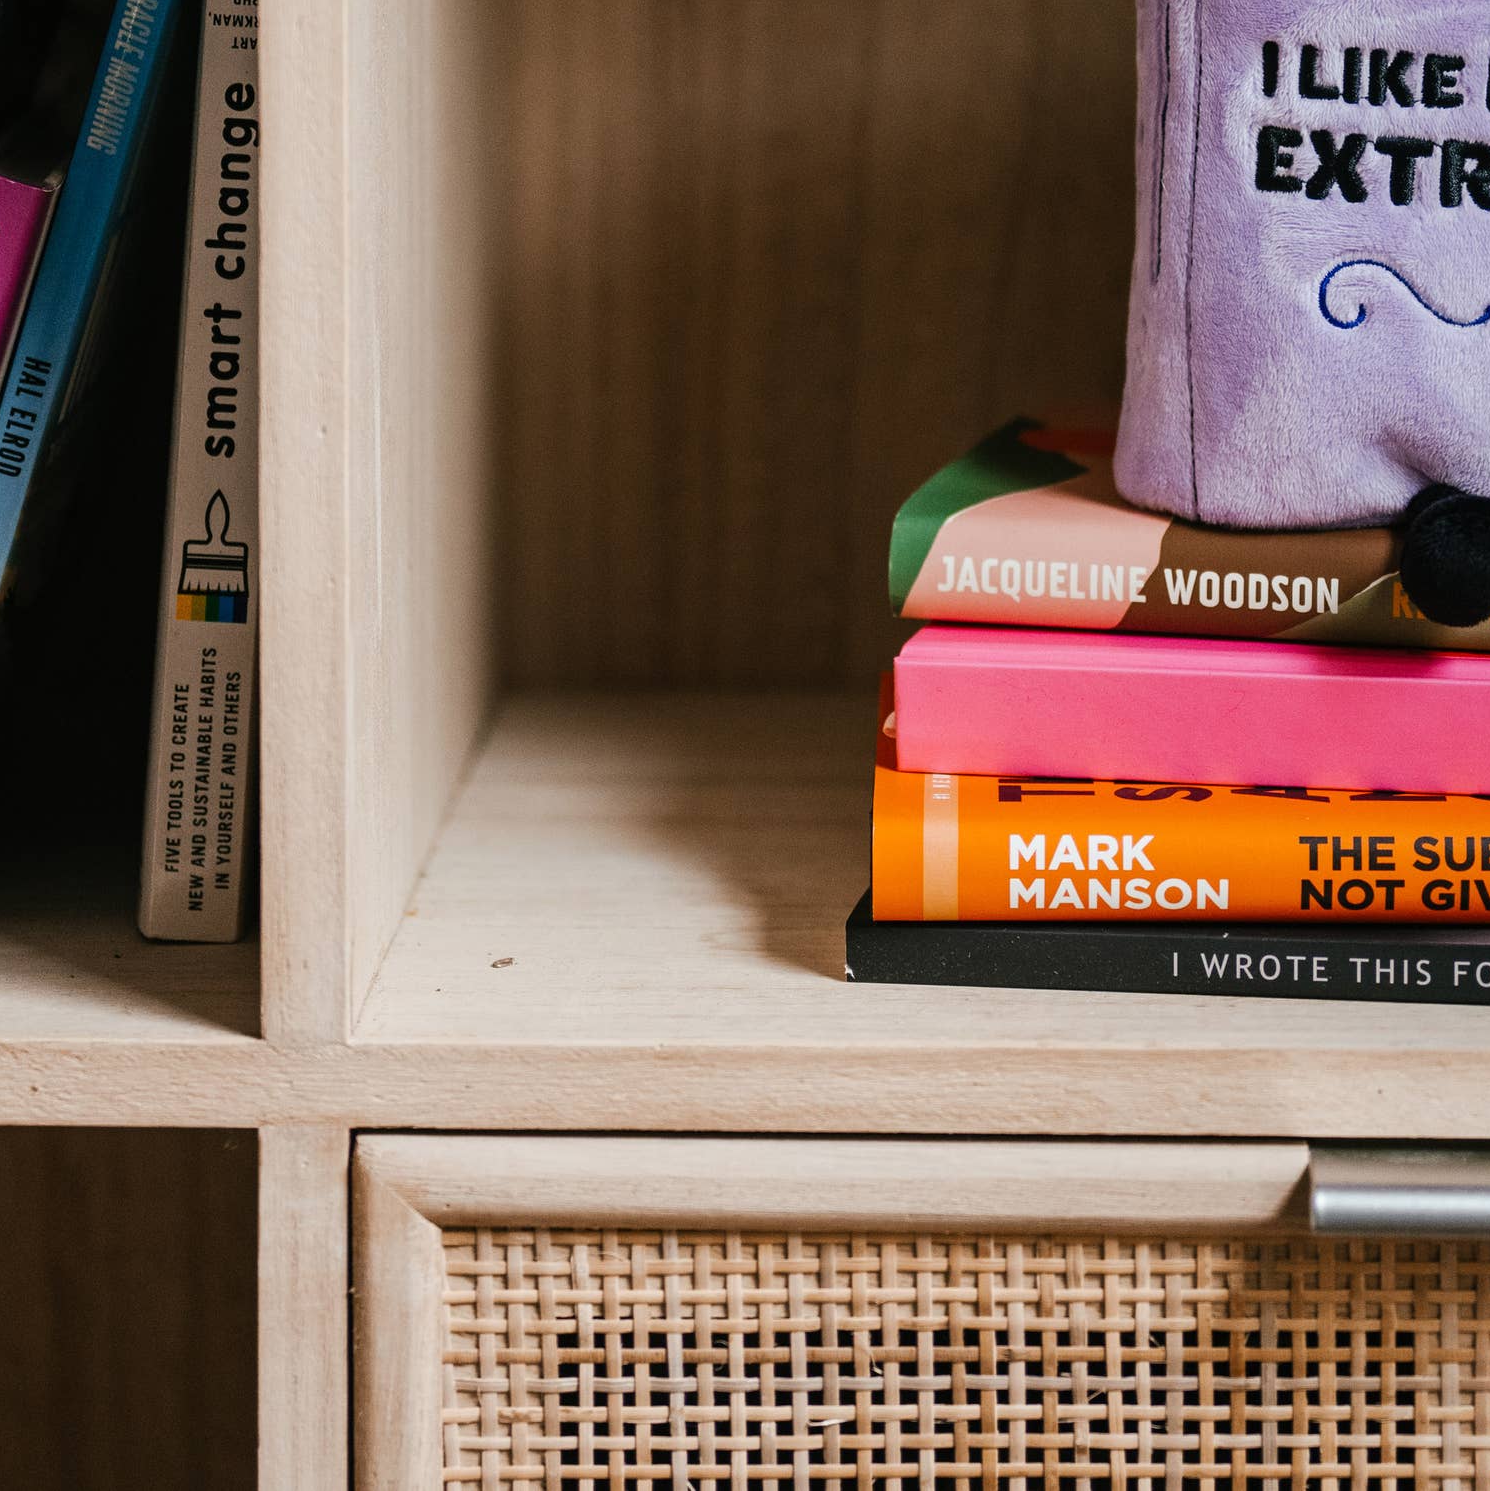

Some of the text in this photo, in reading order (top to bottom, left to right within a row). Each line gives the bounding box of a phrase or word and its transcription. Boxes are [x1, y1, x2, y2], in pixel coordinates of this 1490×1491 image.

[1262, 40, 1279, 98] I
[1298, 43, 1466, 109] LIKE
[86, 57, 141, 156] MORNING
[203, 81, 259, 459] smart change
[15, 356, 52, 399] HAL
[936, 554, 1148, 603] JACQUELINE
[1163, 567, 1340, 615] WOODSON
[164, 684, 190, 873] FIVE TOOLS TO CREATE
[188, 647, 217, 911] NEW AND SUSTAINABLE HABITS
[214, 671, 241, 890] IN YOURSELF AND OTHERS
[1008, 833, 1156, 872] MARK
[1299, 835, 1397, 872] THE
[1008, 877, 1230, 911] MANSON
[1299, 878, 1406, 911] NOT
[1172, 952, 1179, 977] I
[1200, 952, 1329, 983] WROTE
[1348, 957, 1432, 987] THIS
